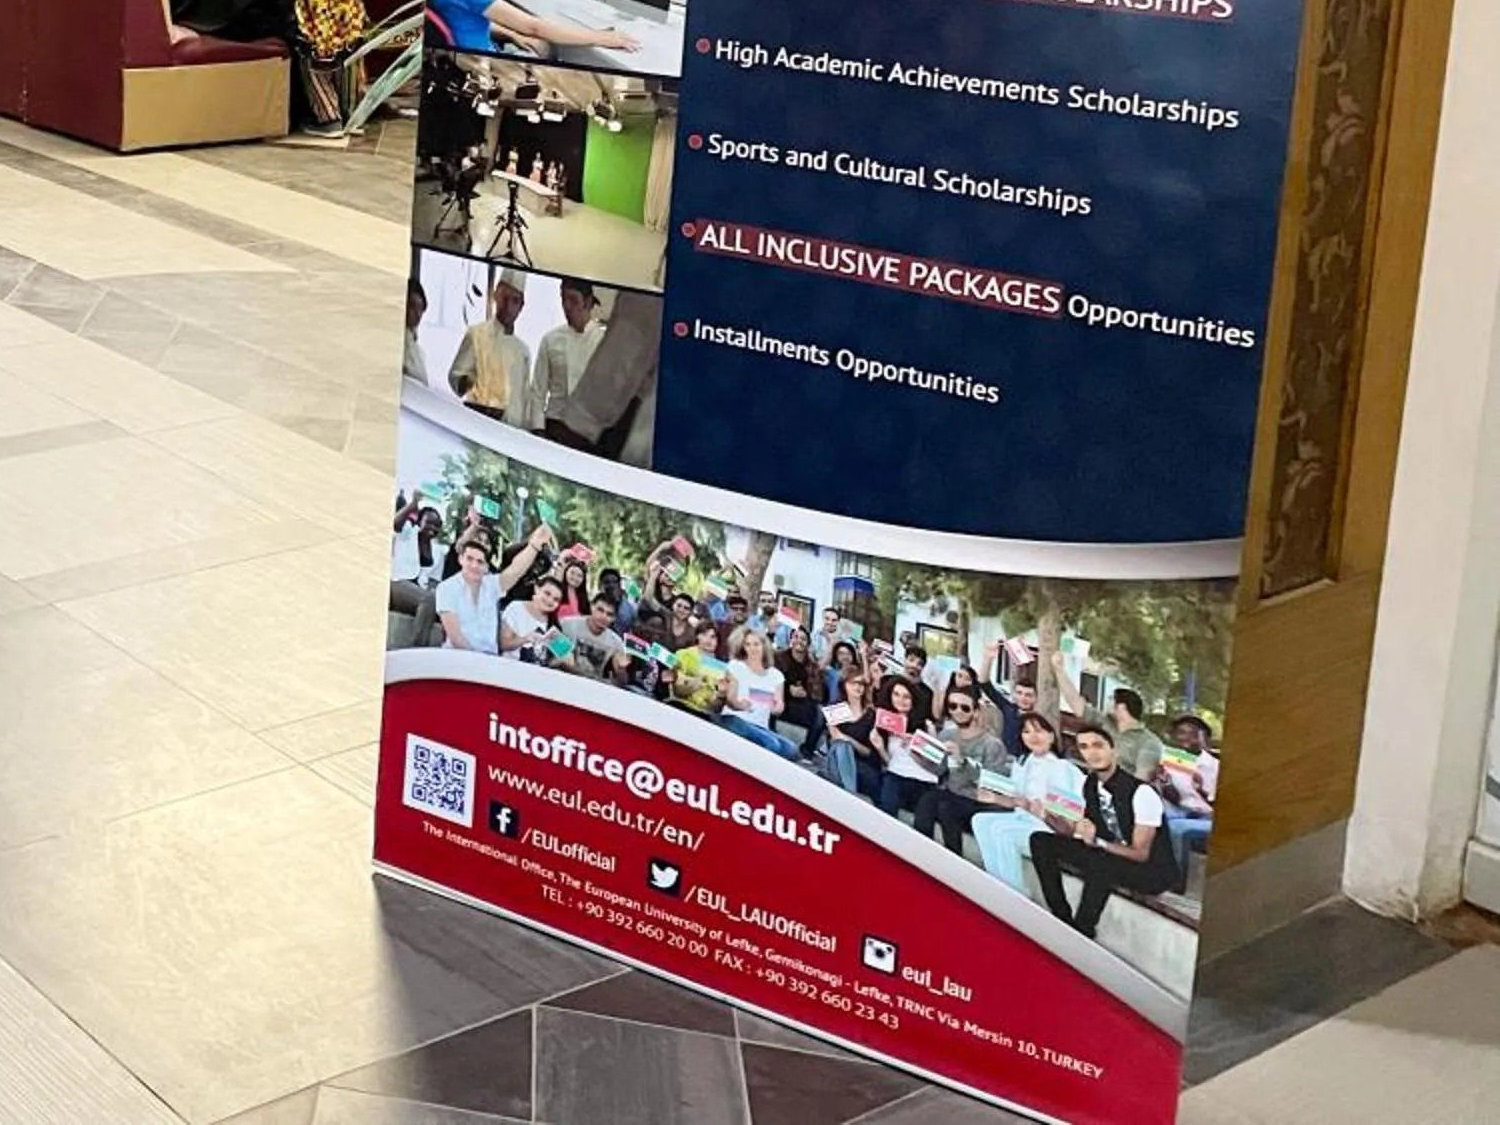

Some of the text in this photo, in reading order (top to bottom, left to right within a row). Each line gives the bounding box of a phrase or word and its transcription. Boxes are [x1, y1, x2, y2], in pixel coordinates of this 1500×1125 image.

[715, 40, 1239, 130] High Academic Achievements Scholarships
[707, 134, 1091, 215] Sports and Cultural Scholarships
[700, 224, 1255, 348] ALL INCLUSIVE PACKAGES Opportunities
[693, 319, 999, 404] Installments Opportunities
[488, 712, 840, 855] intoffice@eul.edu.tr
[488, 764, 705, 852] www.eul.edu.tr/en/
[423, 821, 444, 839] The
[446, 830, 518, 866] International
[521, 858, 557, 883] Office,
[560, 872, 581, 889] The
[585, 881, 641, 912] European
[644, 902, 706, 937] University
[709, 927, 724, 940] of
[897, 994, 935, 1020] TRNC
[937, 1010, 960, 1029] Via
[963, 1020, 1013, 1048] Mersin
[1041, 1047, 1104, 1080] TURKEY
[542, 884, 566, 906] TEL
[577, 900, 604, 918] +90
[607, 909, 633, 930] 392
[636, 922, 664, 941] 660
[667, 932, 687, 950] 20
[689, 938, 709, 958] 00
[714, 949, 744, 971] FAX
[756, 968, 785, 987] +90
[789, 977, 818, 1000] 392
[821, 991, 851, 1012] 660
[854, 1002, 875, 1020] 23
[878, 1012, 899, 1030] 43
[902, 966, 972, 1002] eul_lau
